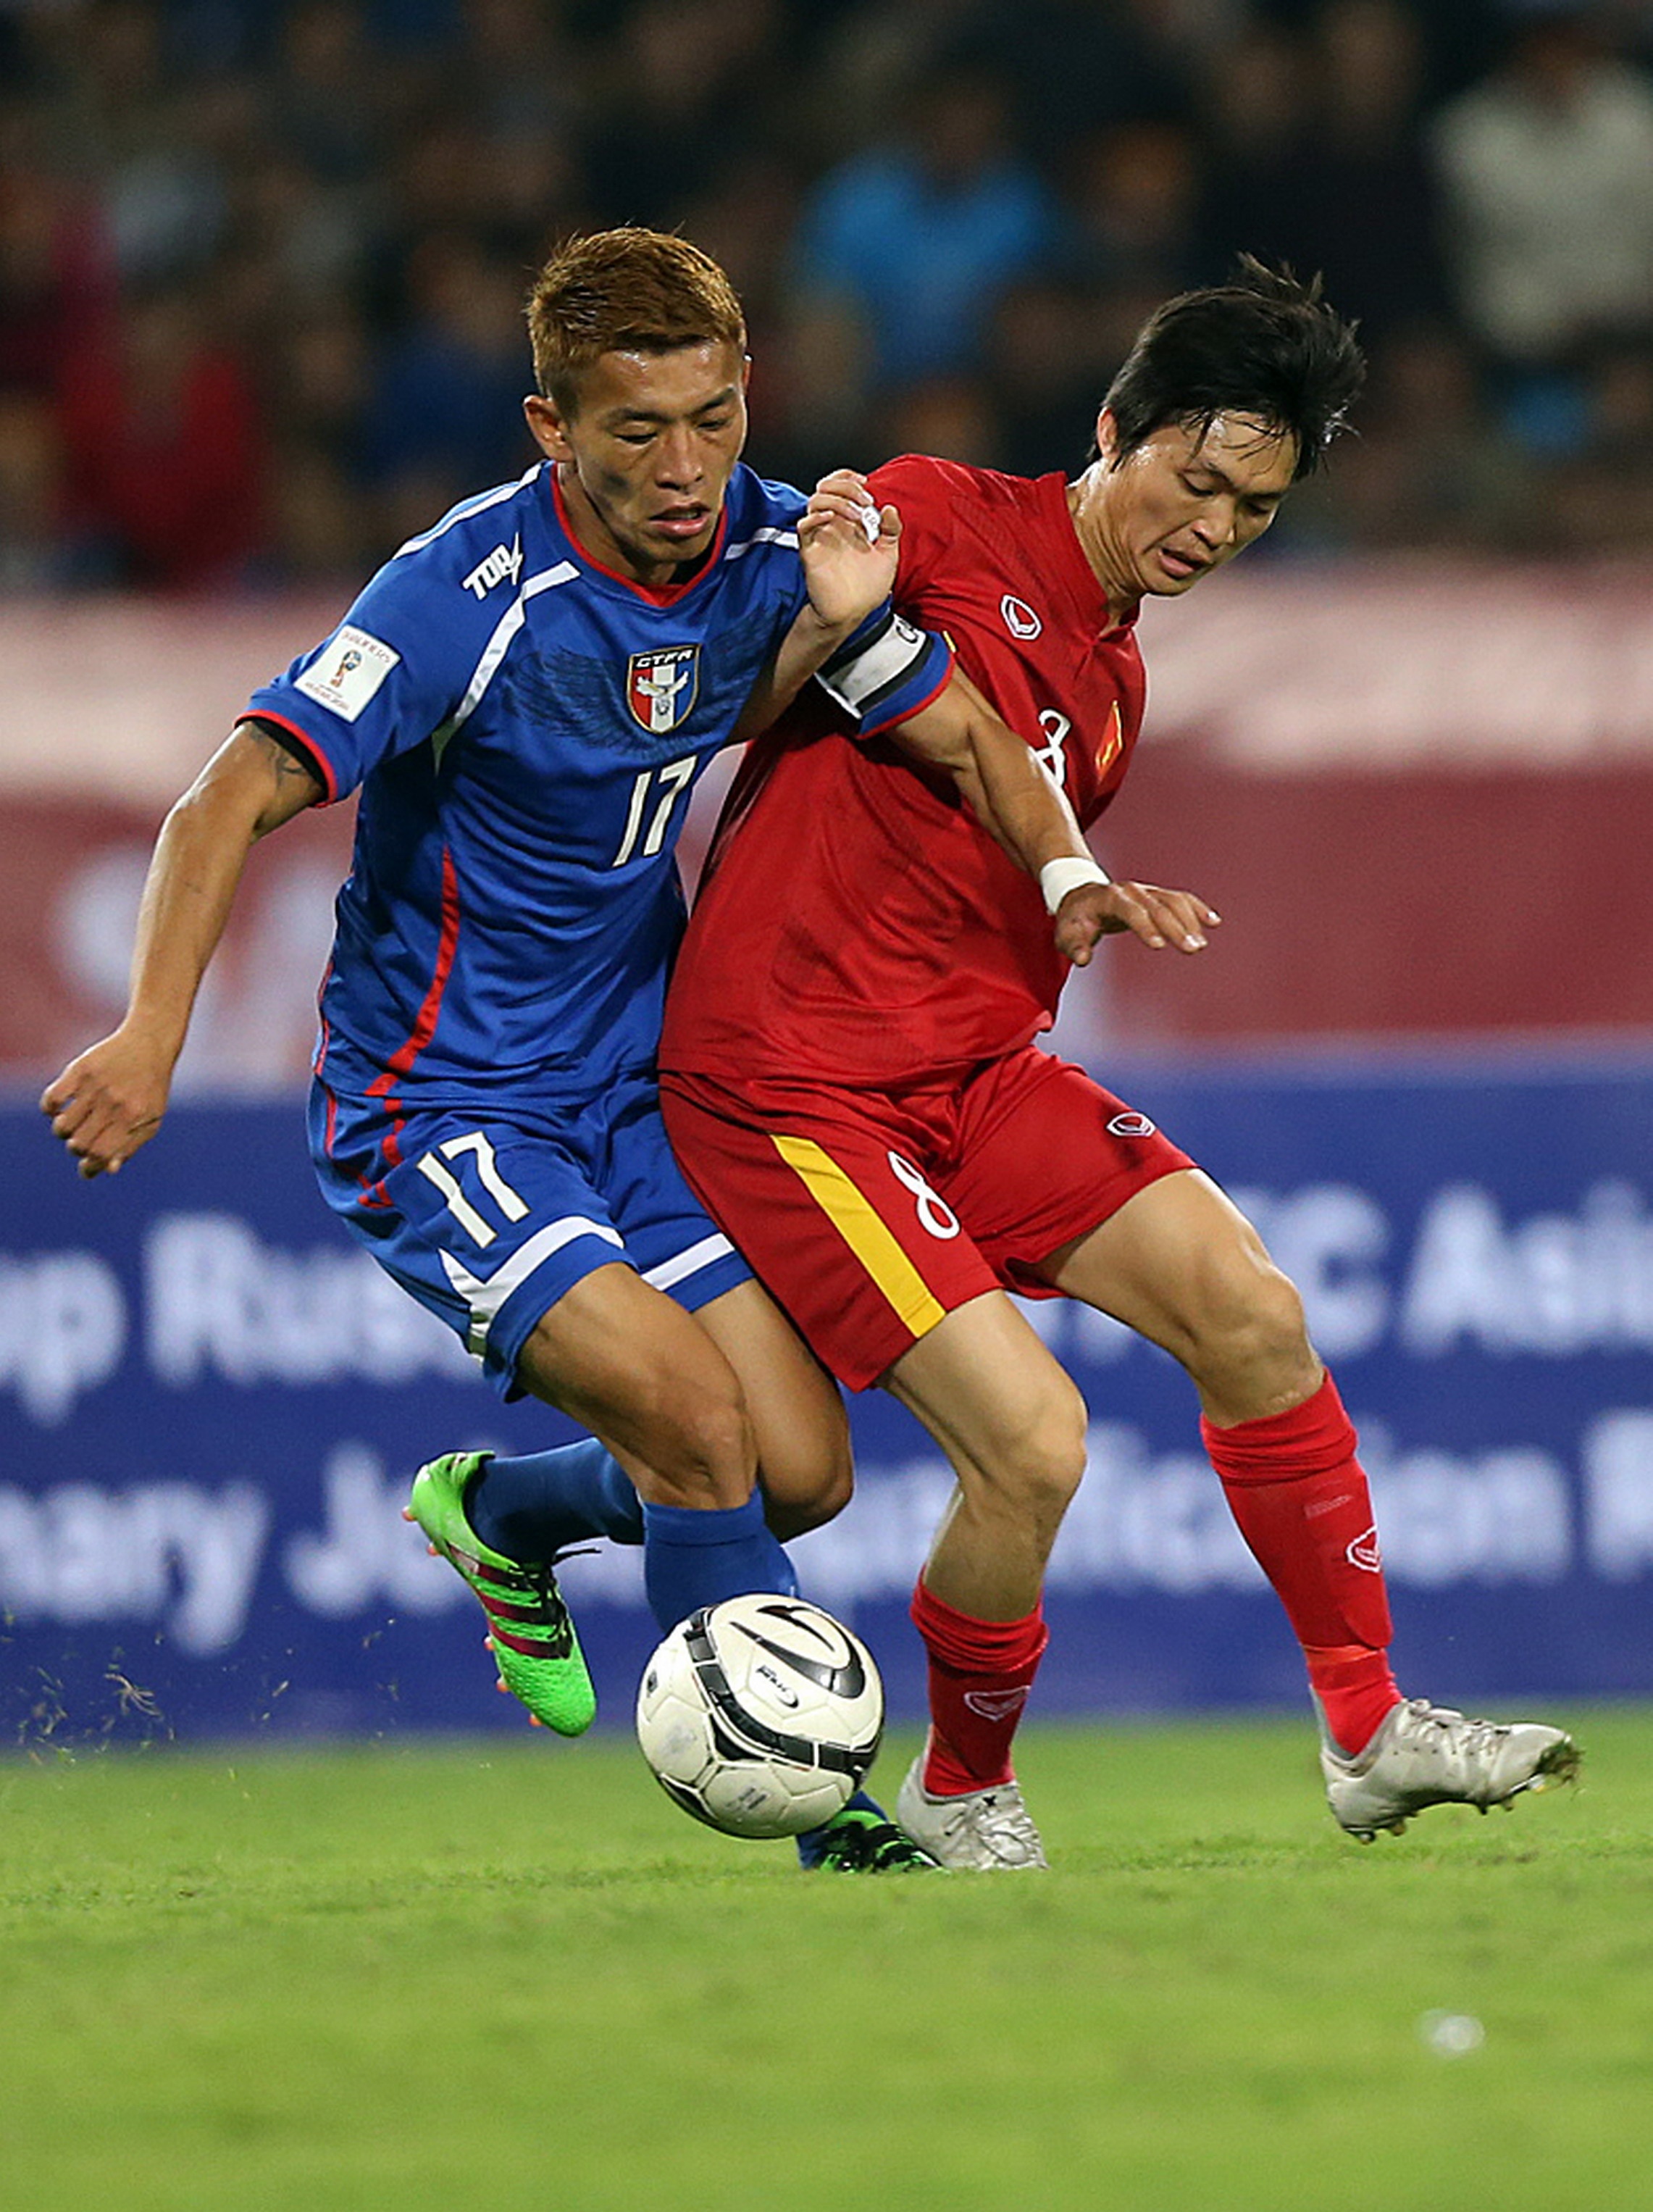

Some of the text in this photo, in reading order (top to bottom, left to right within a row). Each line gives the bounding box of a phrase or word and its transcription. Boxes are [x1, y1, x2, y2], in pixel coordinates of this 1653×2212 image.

[613, 756, 698, 867] 17
[417, 1132, 530, 1248] 17
[887, 1151, 961, 1240] 8
